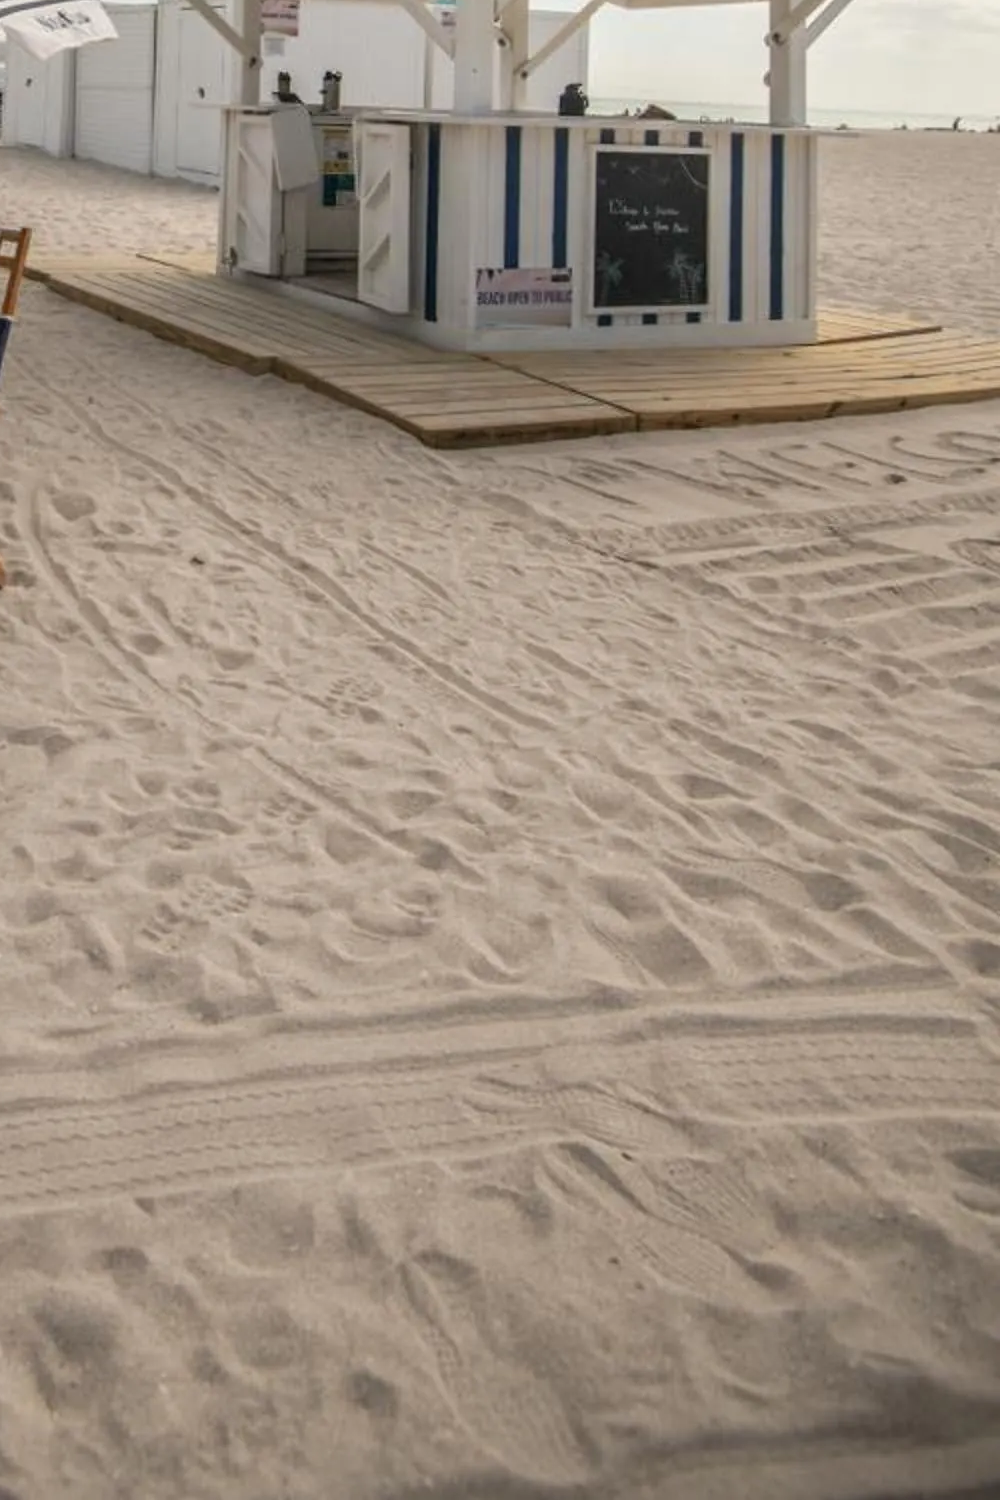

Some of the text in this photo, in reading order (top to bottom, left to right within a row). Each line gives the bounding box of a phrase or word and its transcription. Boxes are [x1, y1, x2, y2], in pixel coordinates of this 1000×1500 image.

[477, 291, 505, 305] BEACH
[507, 291, 529, 305] OPEN
[531, 291, 542, 304] TO
